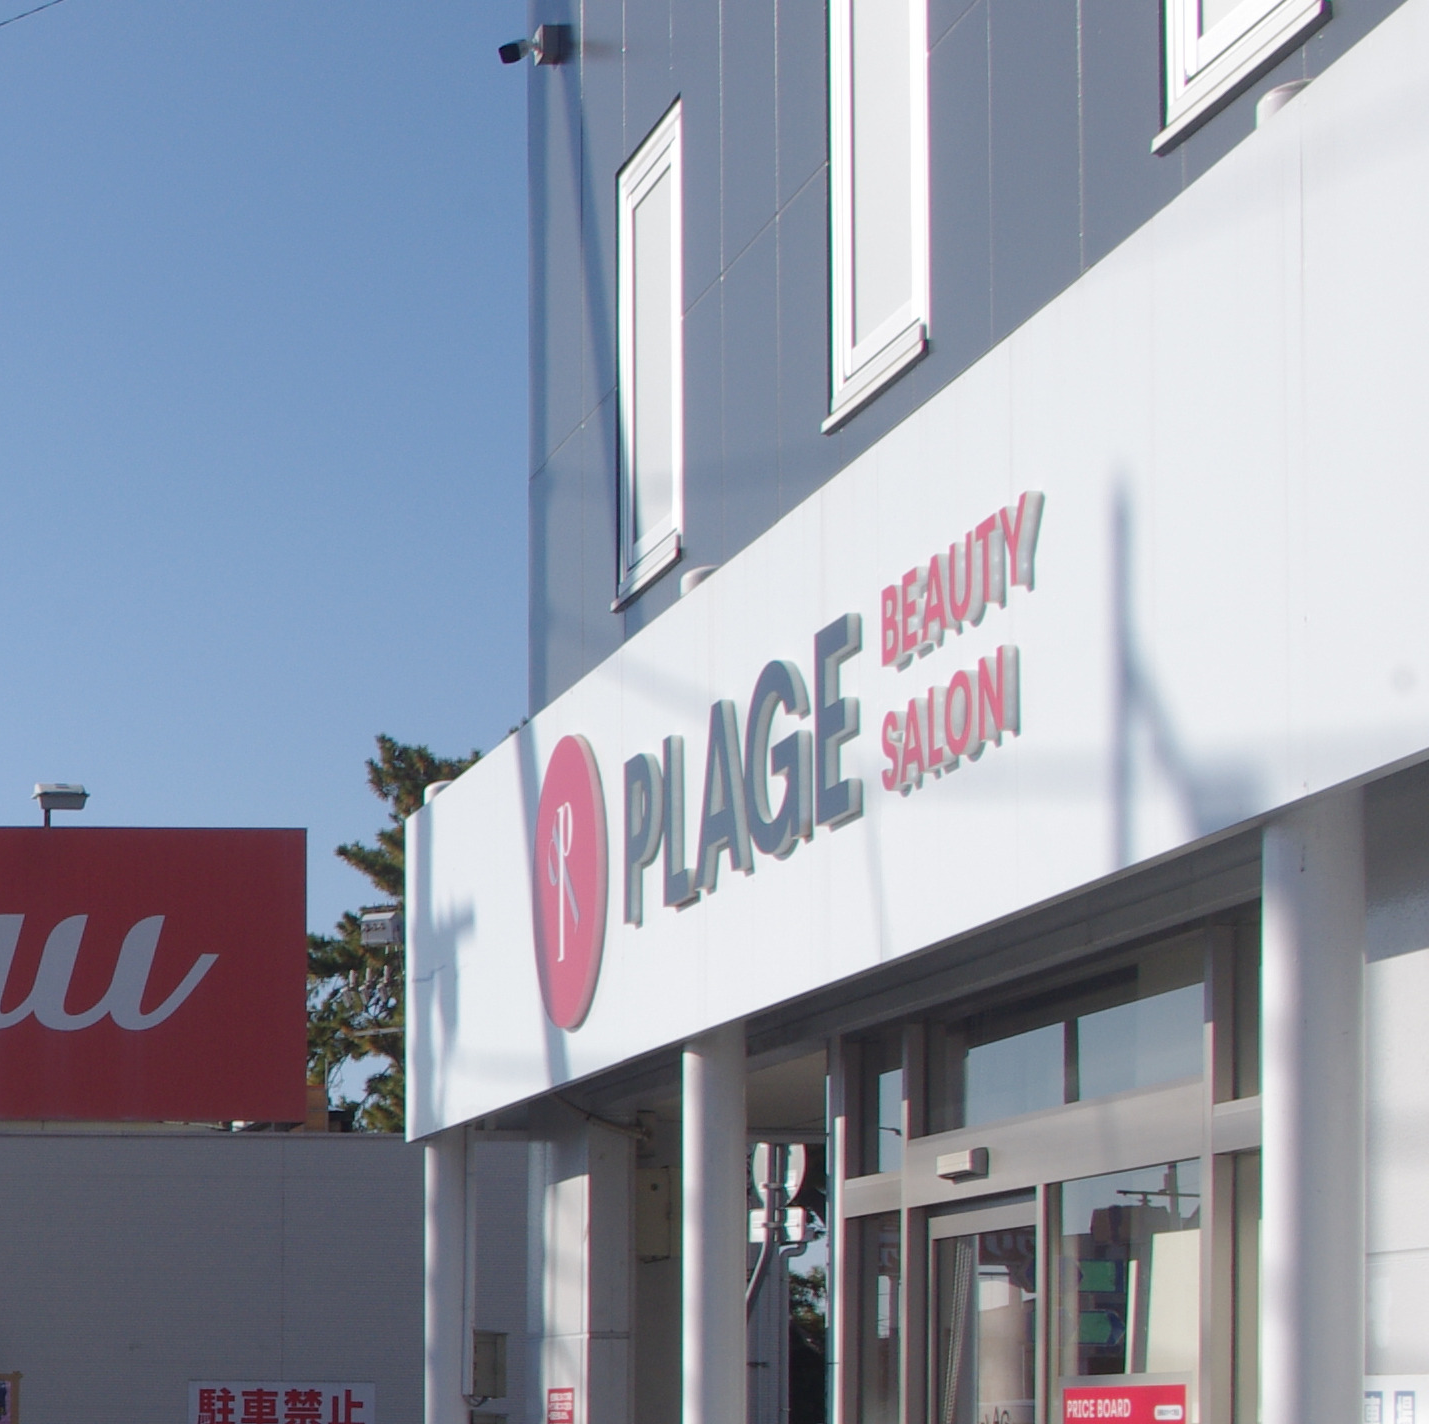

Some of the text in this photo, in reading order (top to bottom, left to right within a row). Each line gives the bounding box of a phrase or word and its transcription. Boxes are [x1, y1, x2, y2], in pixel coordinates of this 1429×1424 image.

[881, 490, 1045, 670] BEAUTY
[623, 612, 864, 929] PLAGE
[881, 644, 1021, 797] SALON
[1066, 1398, 1096, 1419] PRICE
[1097, 1397, 1132, 1419] BOARD
